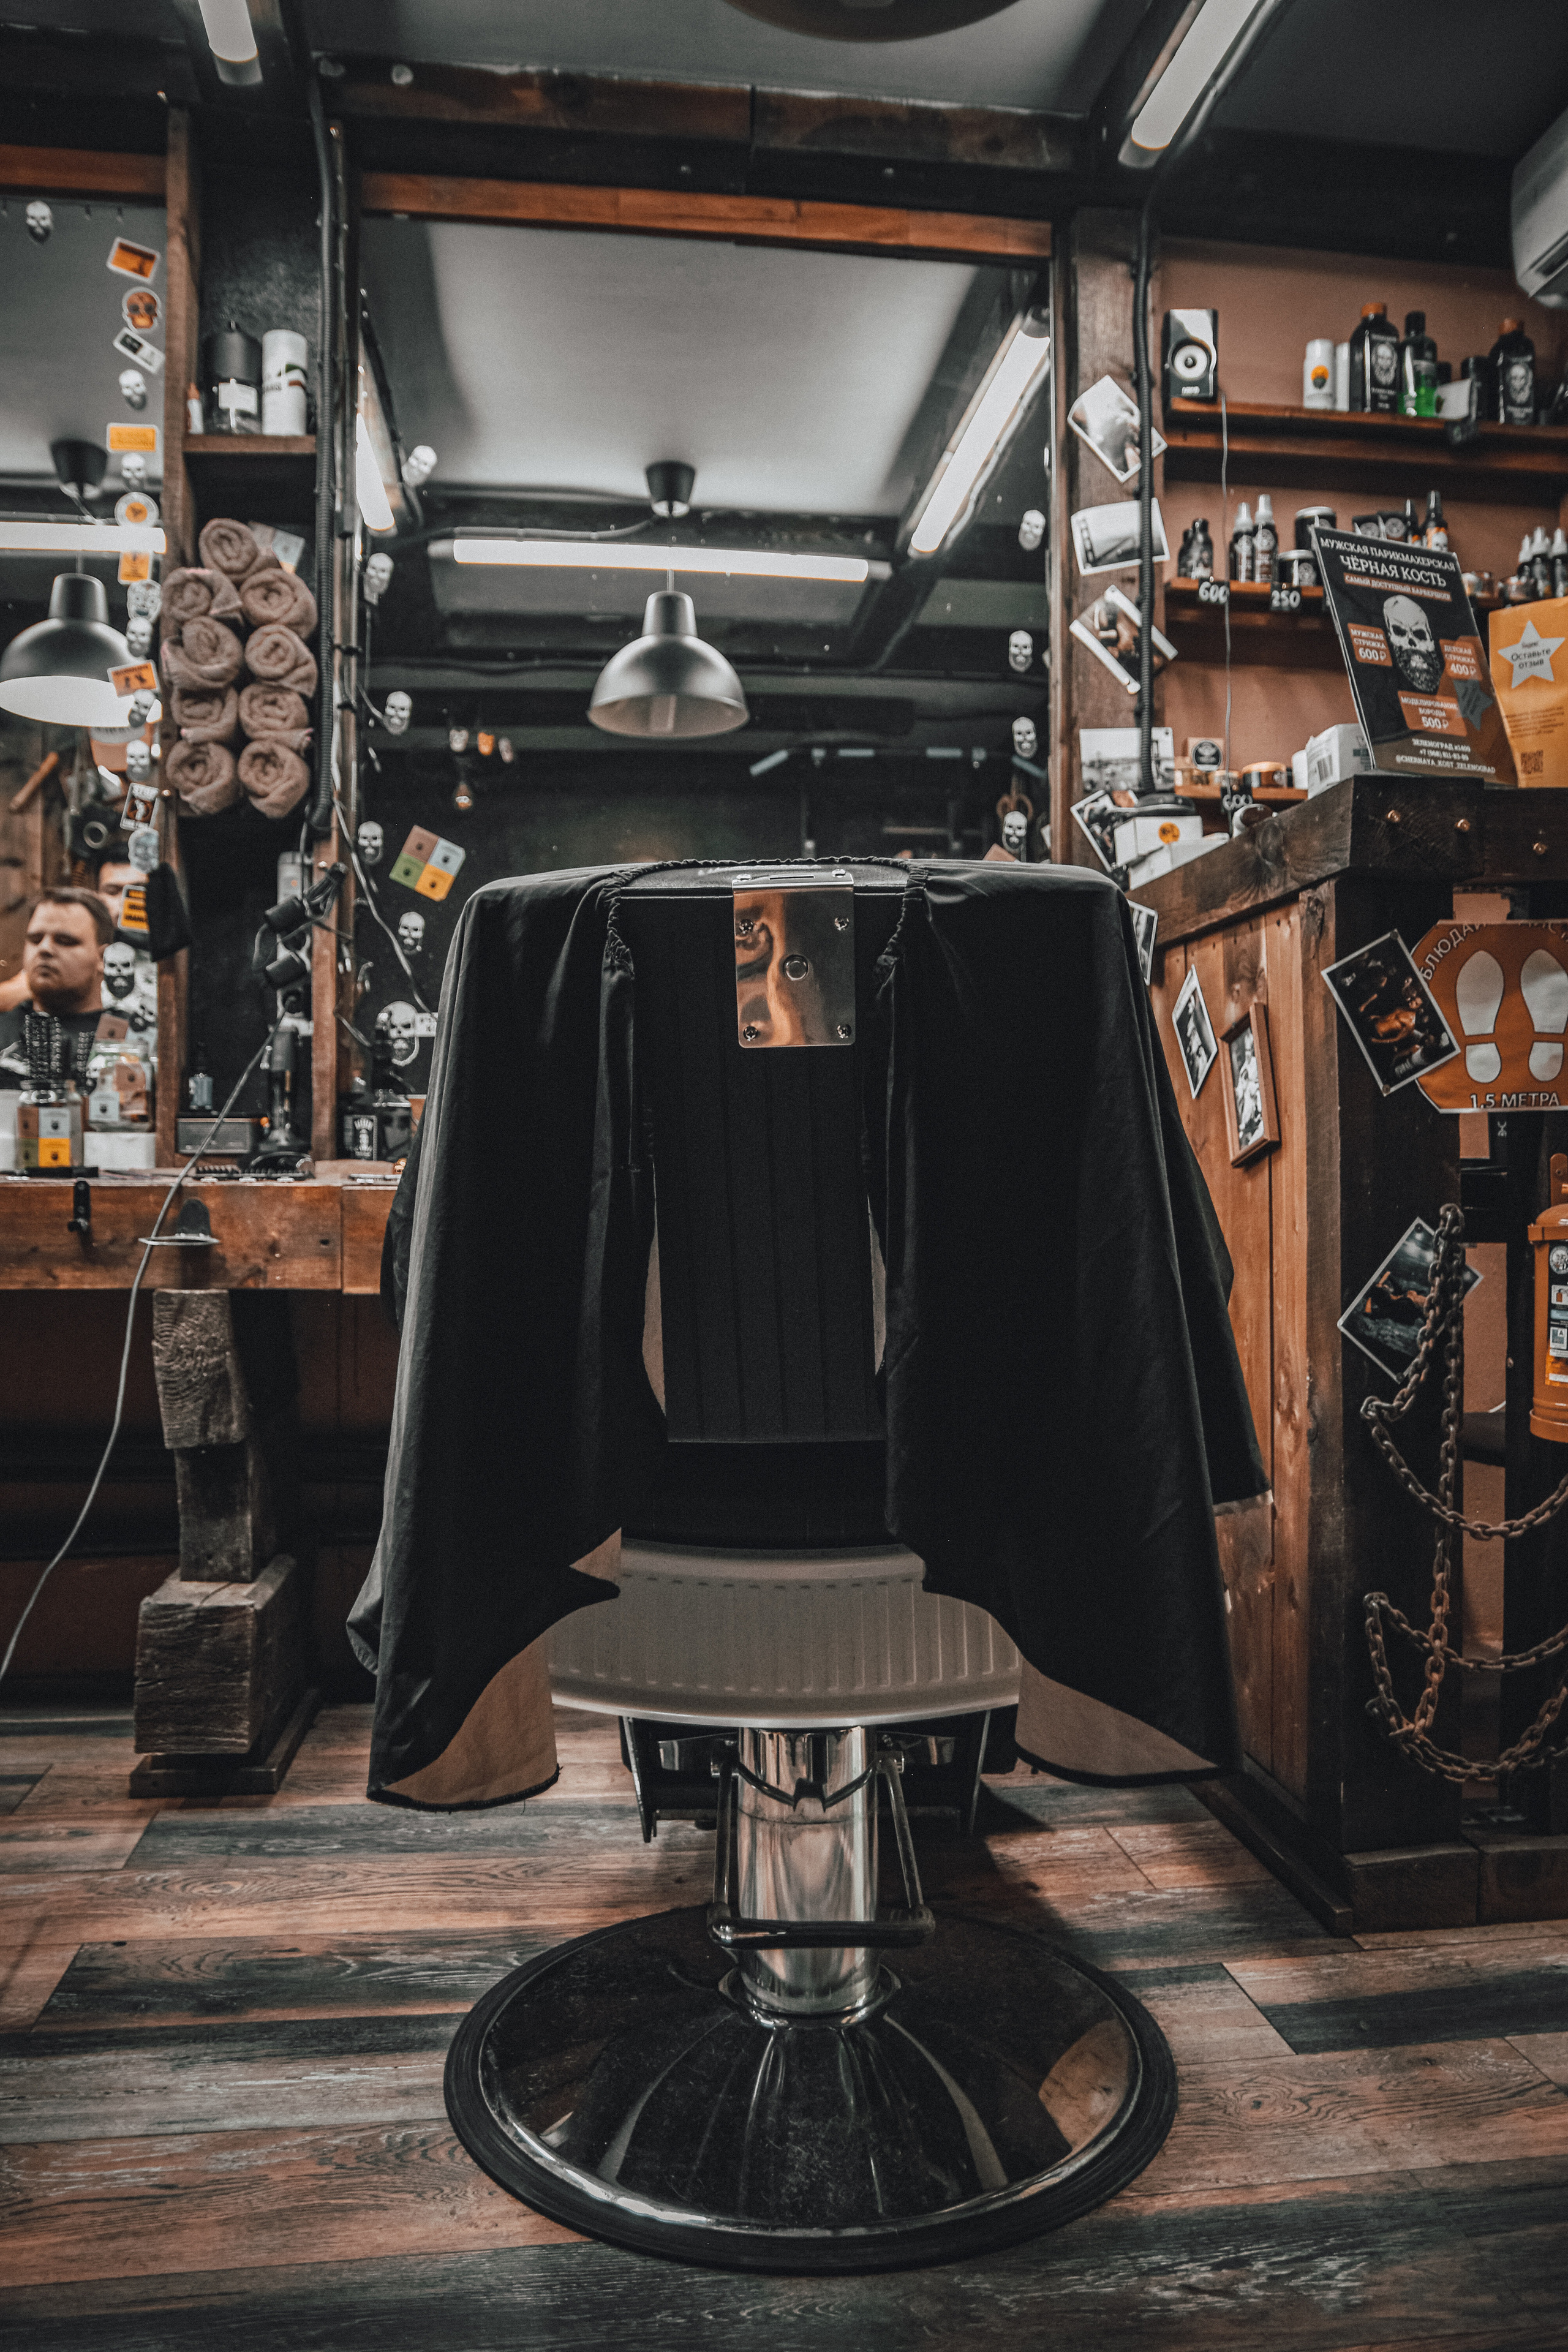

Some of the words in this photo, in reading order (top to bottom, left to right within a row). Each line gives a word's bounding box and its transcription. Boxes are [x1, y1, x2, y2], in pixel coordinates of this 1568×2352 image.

[1320, 537, 1369, 554] МУЖСКАЯ
[1370, 546, 1456, 572] ПАРИКМАХЕРСКАЯ
[1340, 554, 1400, 579] ЧЁРНАЯ
[1400, 566, 1447, 587] КОСТЬ
[1345, 575, 1370, 586] САМЫЙ
[1371, 579, 1411, 593] ДОСТУПНЫЙ
[1199, 581, 1230, 604] 600
[1271, 589, 1301, 608] 250
[1351, 628, 1384, 640] МУЖСКАЯ
[1354, 638, 1386, 649] СТРИЖКА
[1445, 654, 1476, 664] СТРИЖКА
[1511, 648, 1551, 661] Оставьте
[1518, 659, 1544, 669] отзыв
[1401, 696, 1458, 710] МОДЕЛИРОВАНИЕ
[1419, 707, 1446, 717] БОРОДЫ
[1501, 1092, 1560, 1107] МЕТРА
